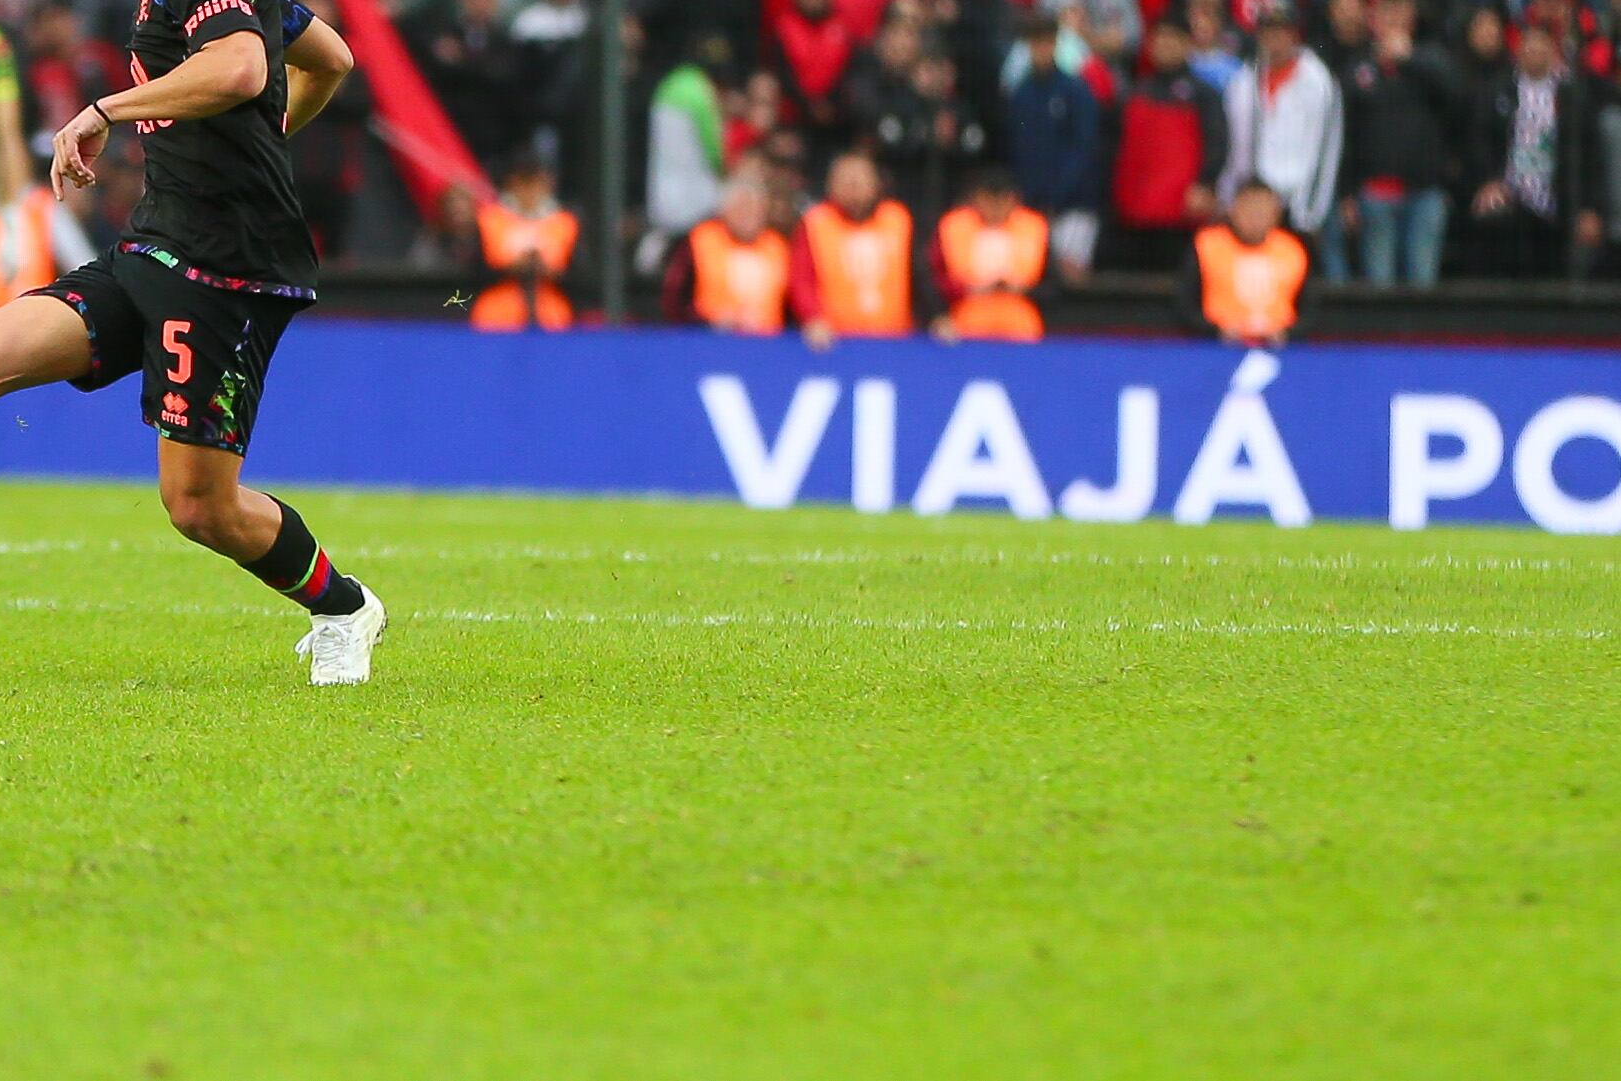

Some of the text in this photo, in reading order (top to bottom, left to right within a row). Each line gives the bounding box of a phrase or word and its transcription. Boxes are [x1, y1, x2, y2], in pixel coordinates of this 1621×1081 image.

[163, 320, 192, 384] 5
[697, 349, 1621, 535] VIAJÁ PO
